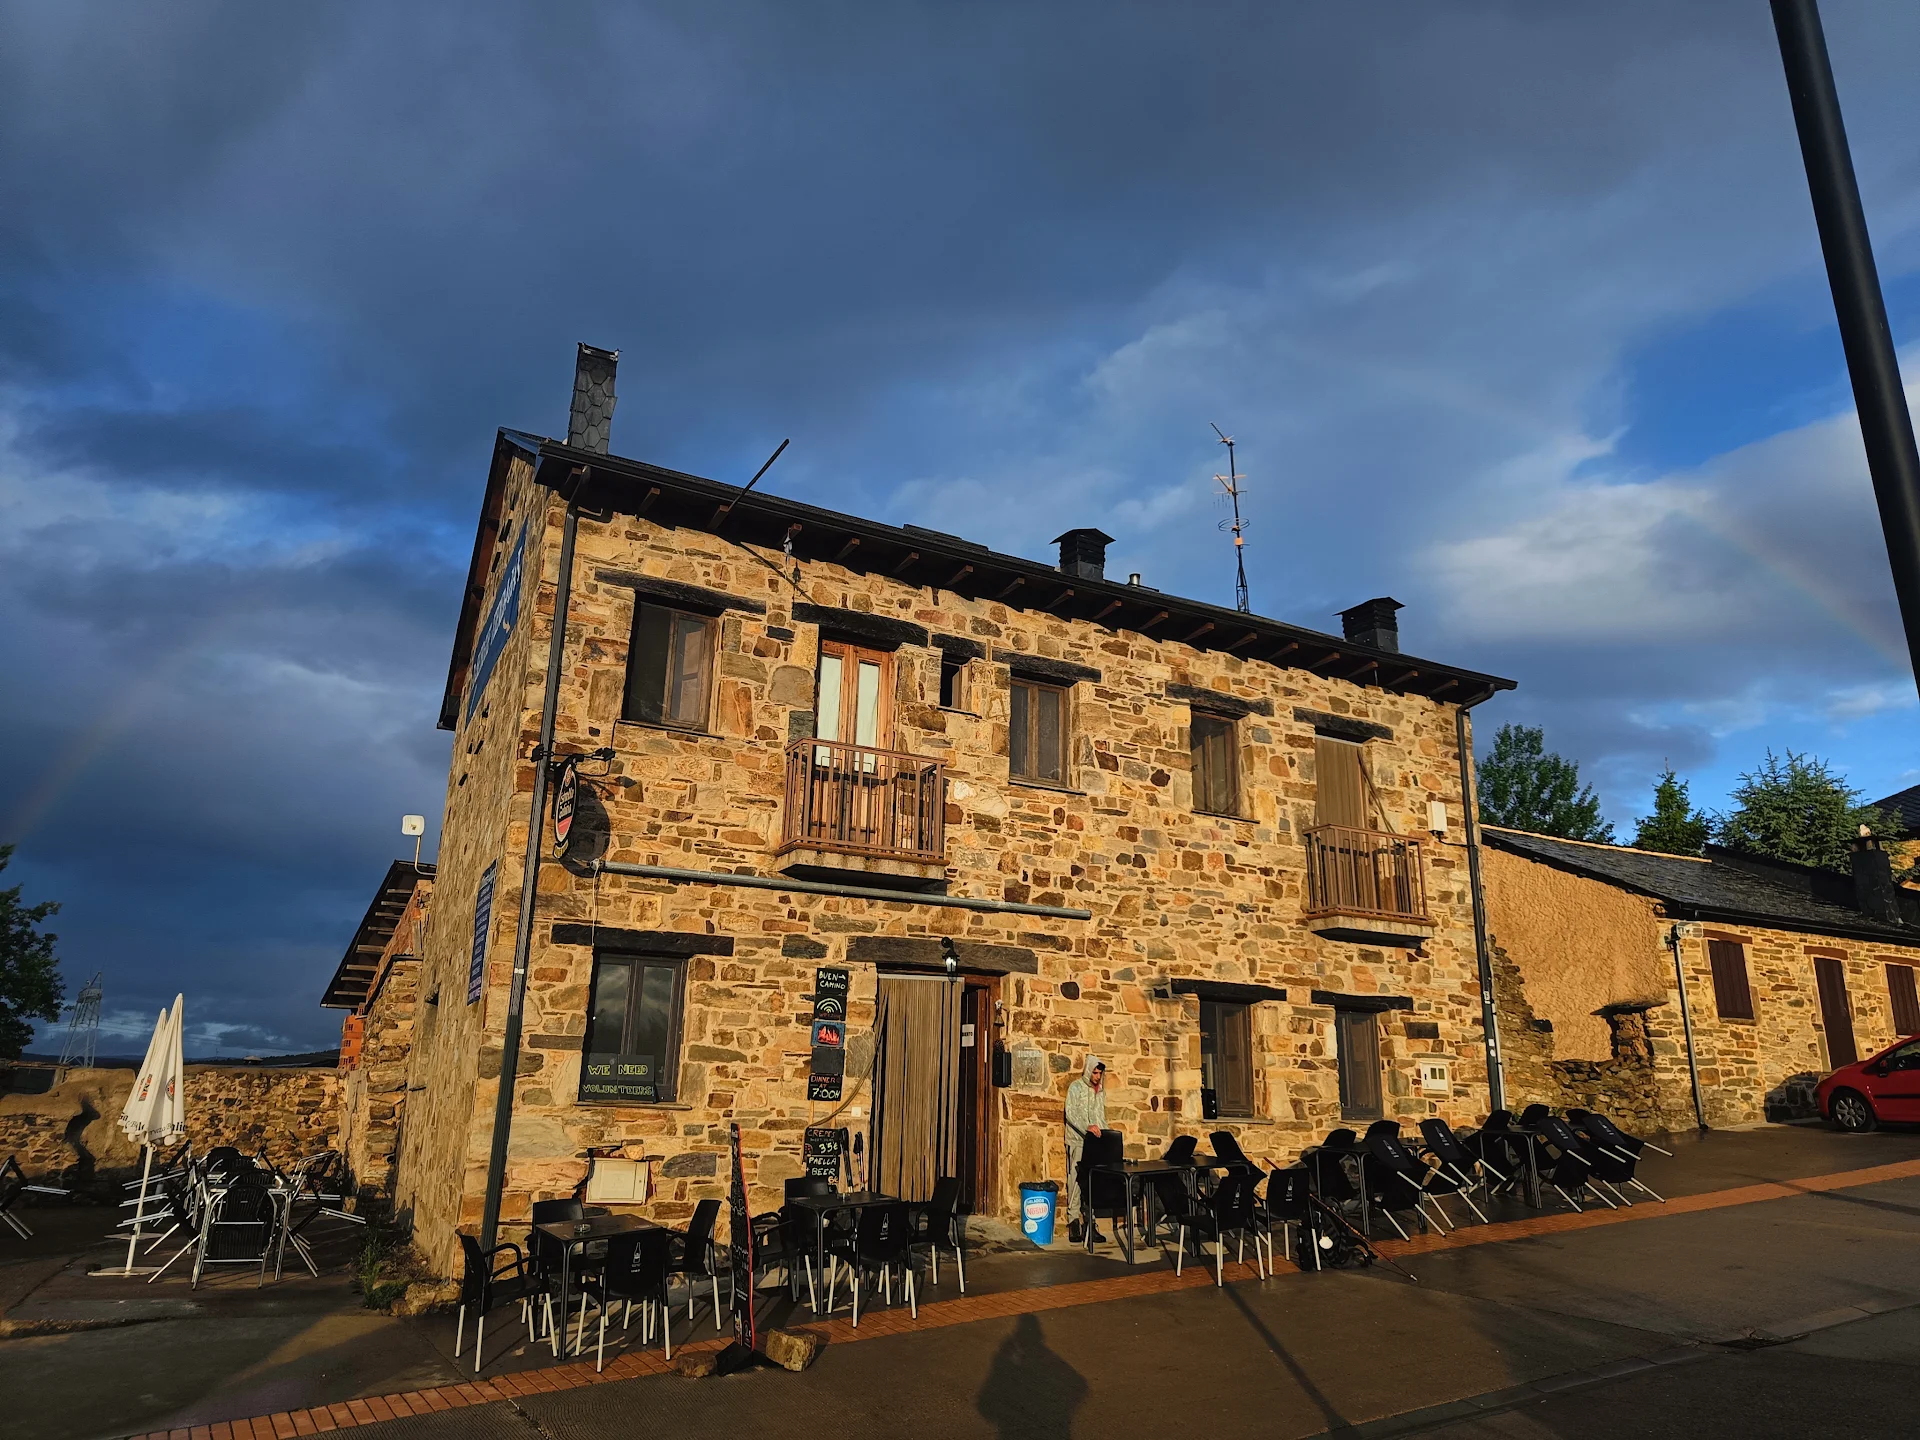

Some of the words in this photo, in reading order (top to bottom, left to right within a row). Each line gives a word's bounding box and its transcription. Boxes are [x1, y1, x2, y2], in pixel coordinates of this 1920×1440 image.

[819, 971, 838, 981] BUEN
[820, 980, 846, 990] CAMINO
[588, 1064, 610, 1075] WE
[618, 1064, 648, 1075] NEED
[809, 1157, 836, 1166] PAELLA
[811, 1167, 836, 1176] BEER
